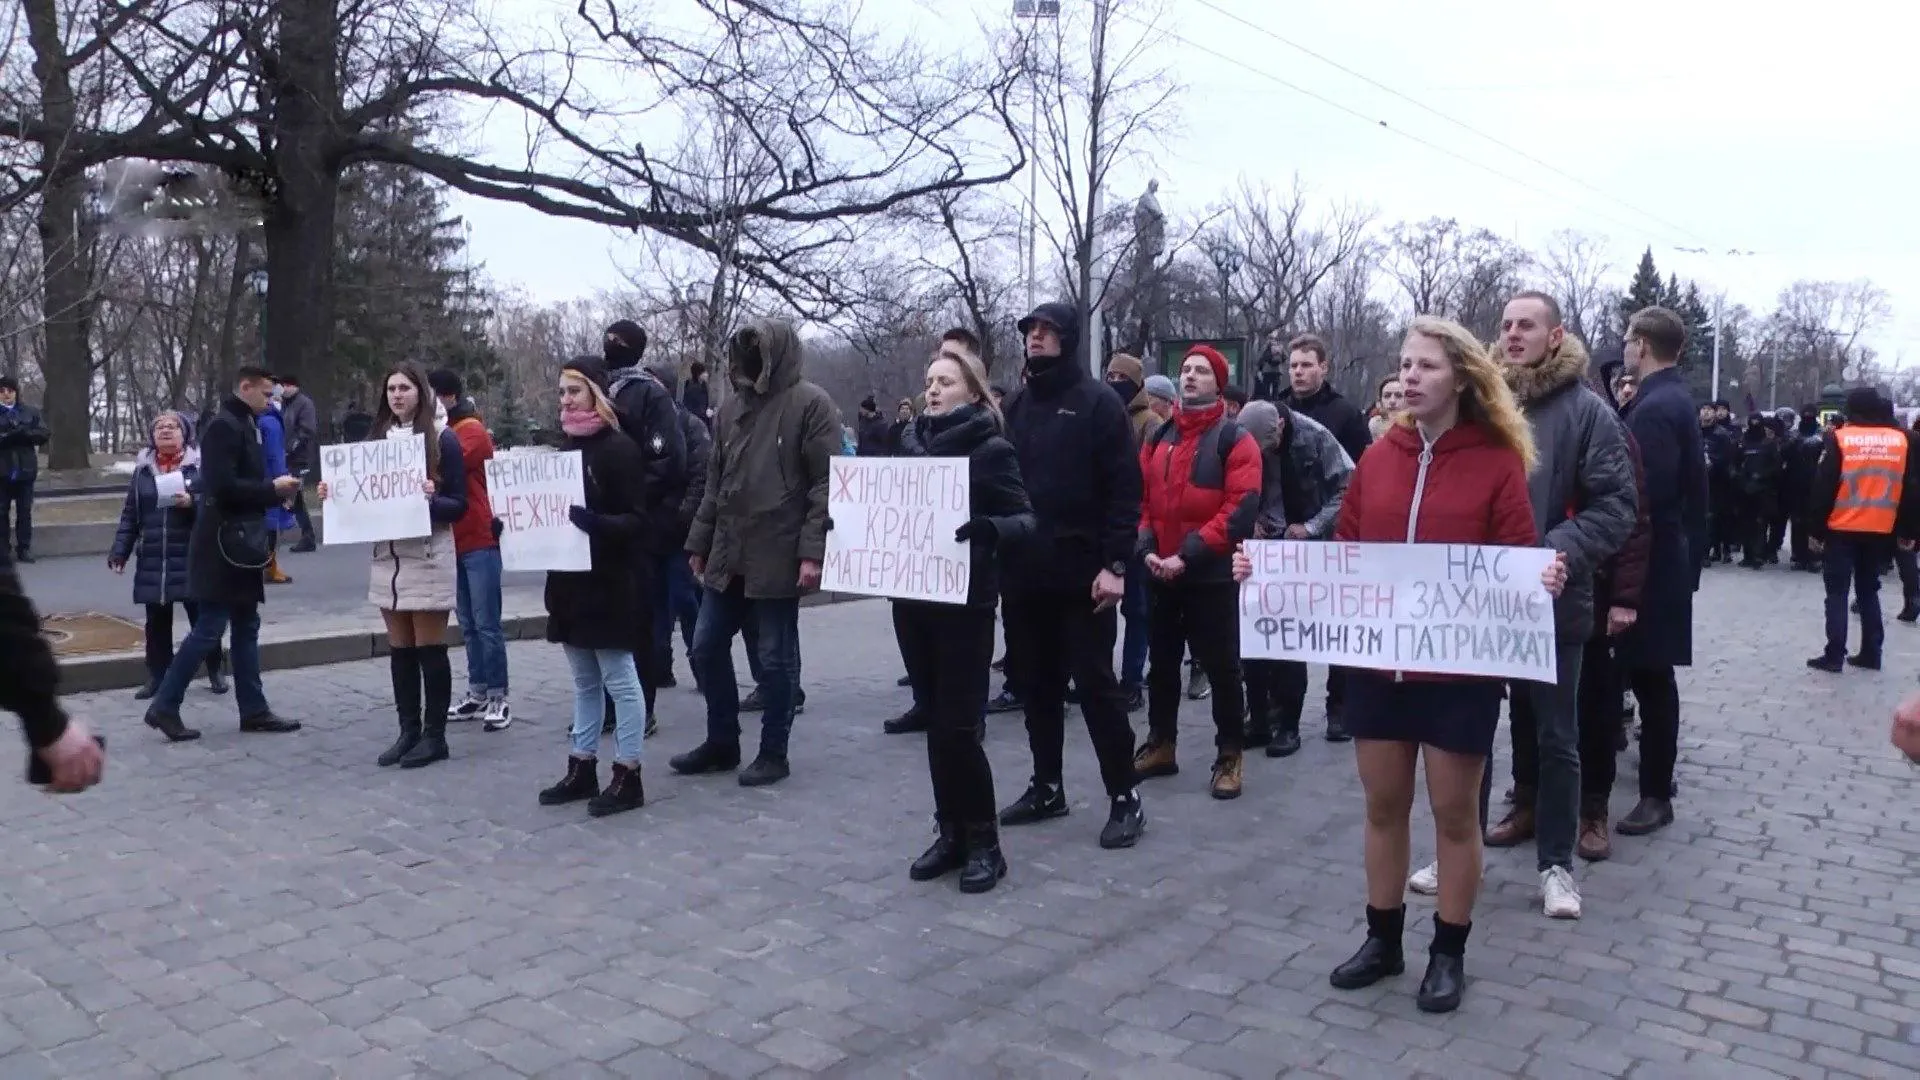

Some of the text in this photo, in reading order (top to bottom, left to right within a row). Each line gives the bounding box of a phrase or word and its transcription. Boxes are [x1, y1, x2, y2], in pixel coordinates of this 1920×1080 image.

[325, 440, 424, 476] ФЕМІНІЗМ
[352, 468, 424, 504] ХВОРОБА
[831, 465, 966, 511] ЖІНОЧНІСТЬ
[491, 493, 574, 532] НЕ ЖІНК
[865, 506, 935, 552] КРАСА
[823, 549, 966, 595] МАТЕРИНСТВО
[1245, 543, 1361, 574] МЕНІ НЕ
[1447, 544, 1509, 583] НАС
[1243, 581, 1394, 618] ПОТРІБЕН
[1409, 580, 1541, 624] ЗАХИЩАЄ
[1254, 617, 1382, 656] ФЕМІНІЗМ
[1394, 623, 1552, 669] ПАТРІАРХАТ
